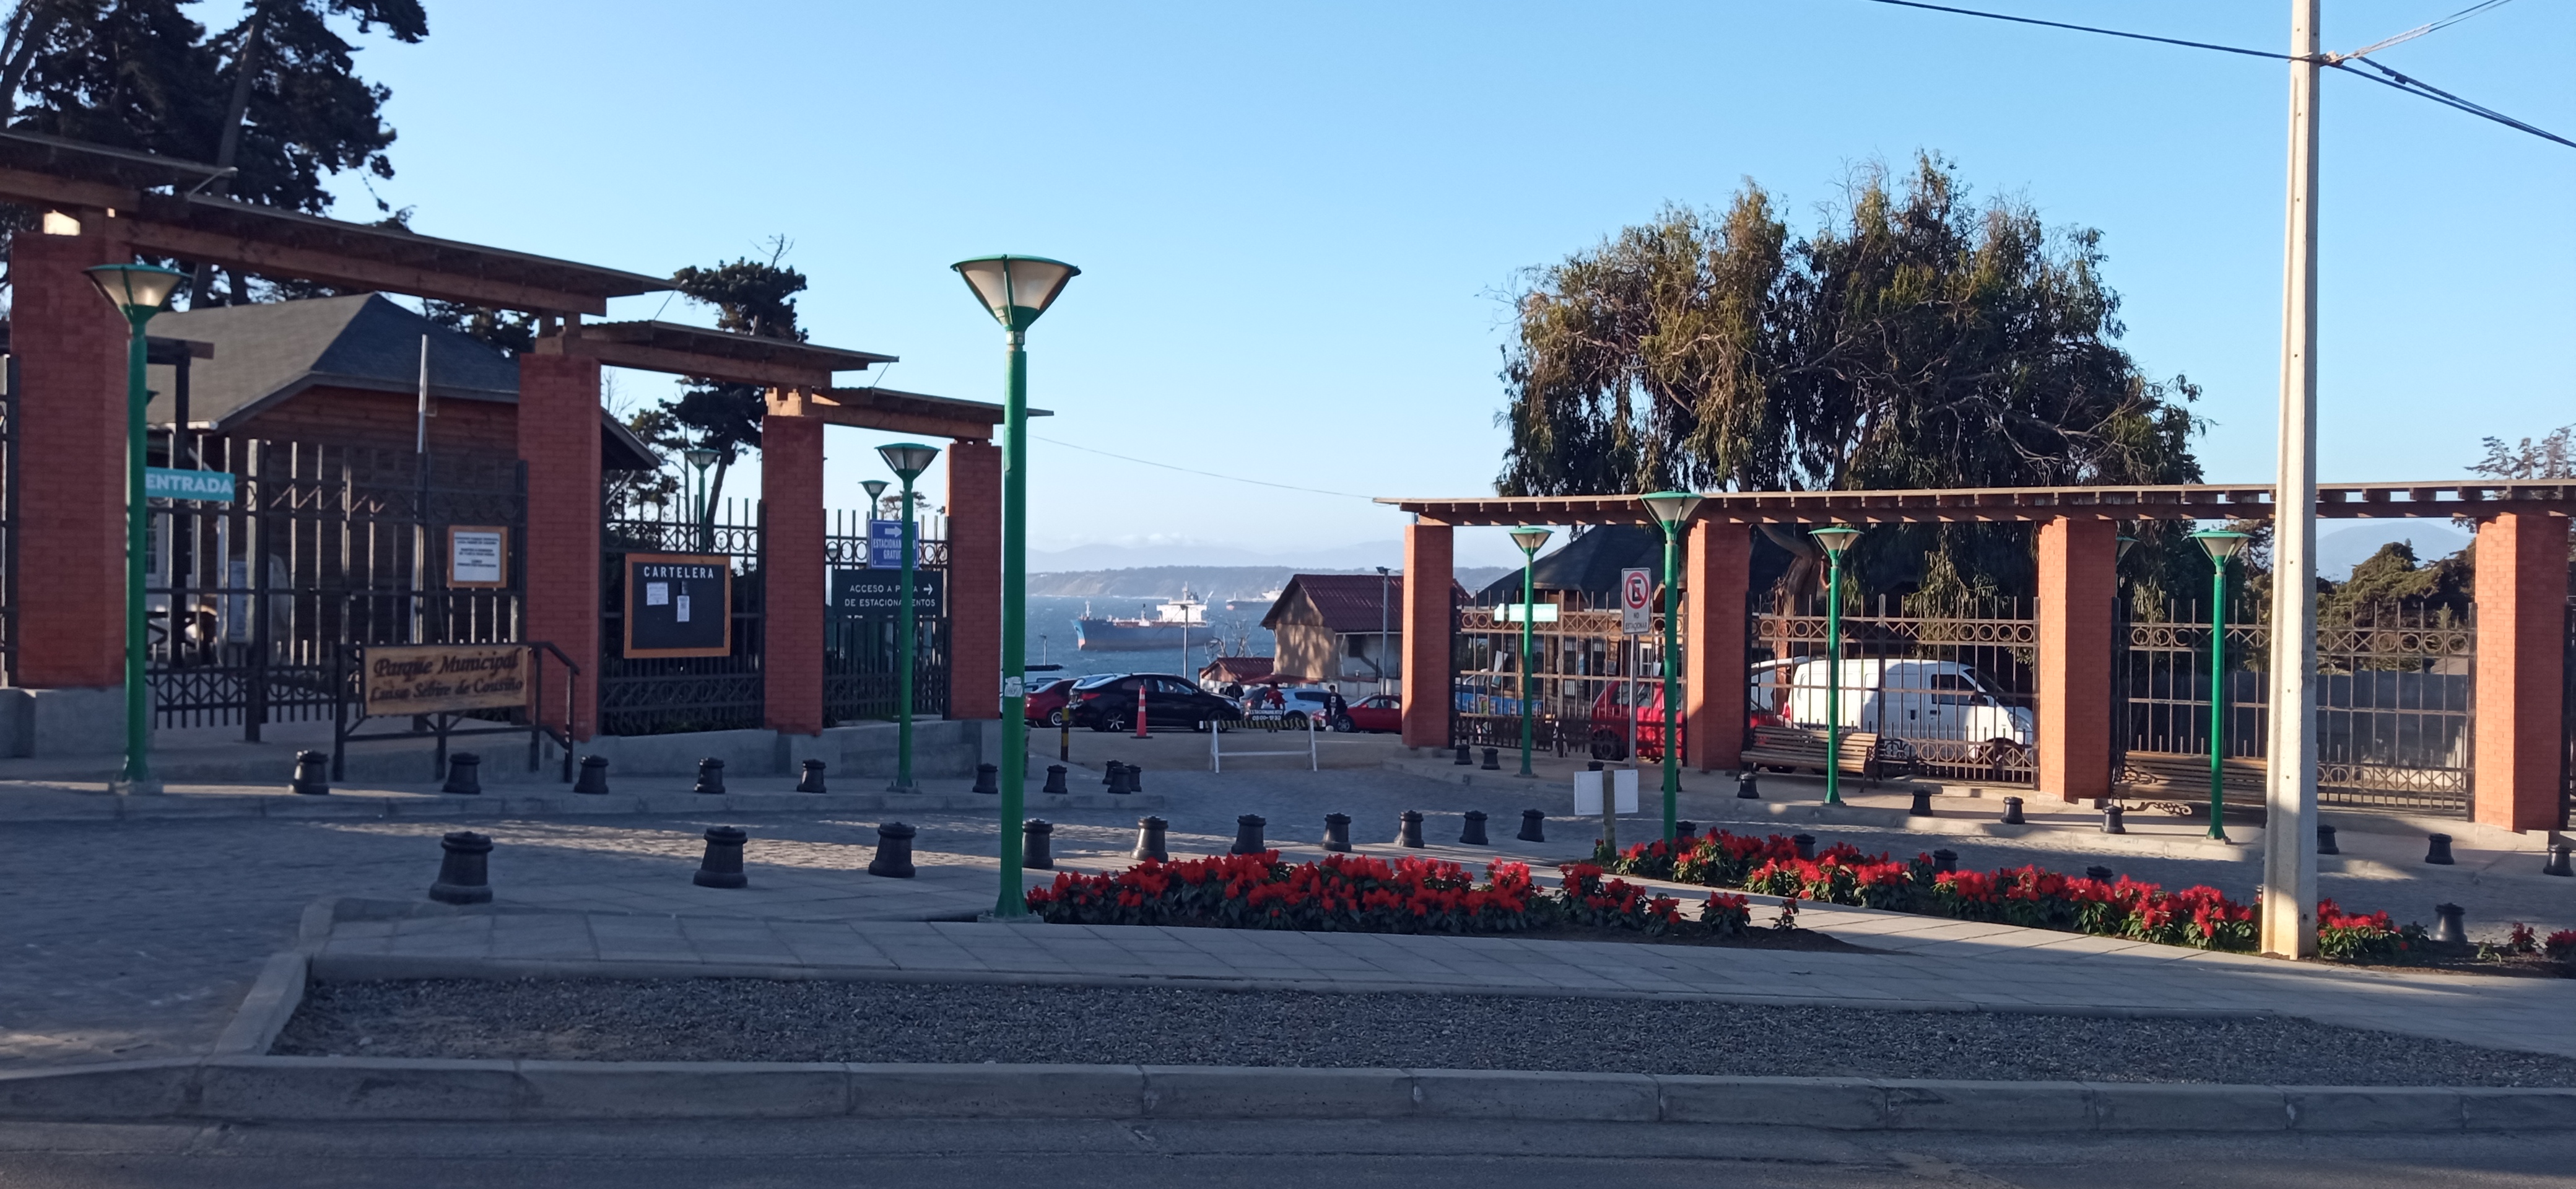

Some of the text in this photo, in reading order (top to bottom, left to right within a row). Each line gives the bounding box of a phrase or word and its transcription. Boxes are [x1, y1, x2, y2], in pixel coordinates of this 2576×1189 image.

[146, 473, 233, 494] ENTRADA
[873, 538, 916, 549] ESTACIONAO
[644, 566, 714, 578] CARTELERA
[850, 585, 884, 593] ACCESO
[845, 598, 936, 607] DE ESTACIONAENTOS
[373, 648, 522, 682] Parque Municipal
[455, 679, 471, 694] de
